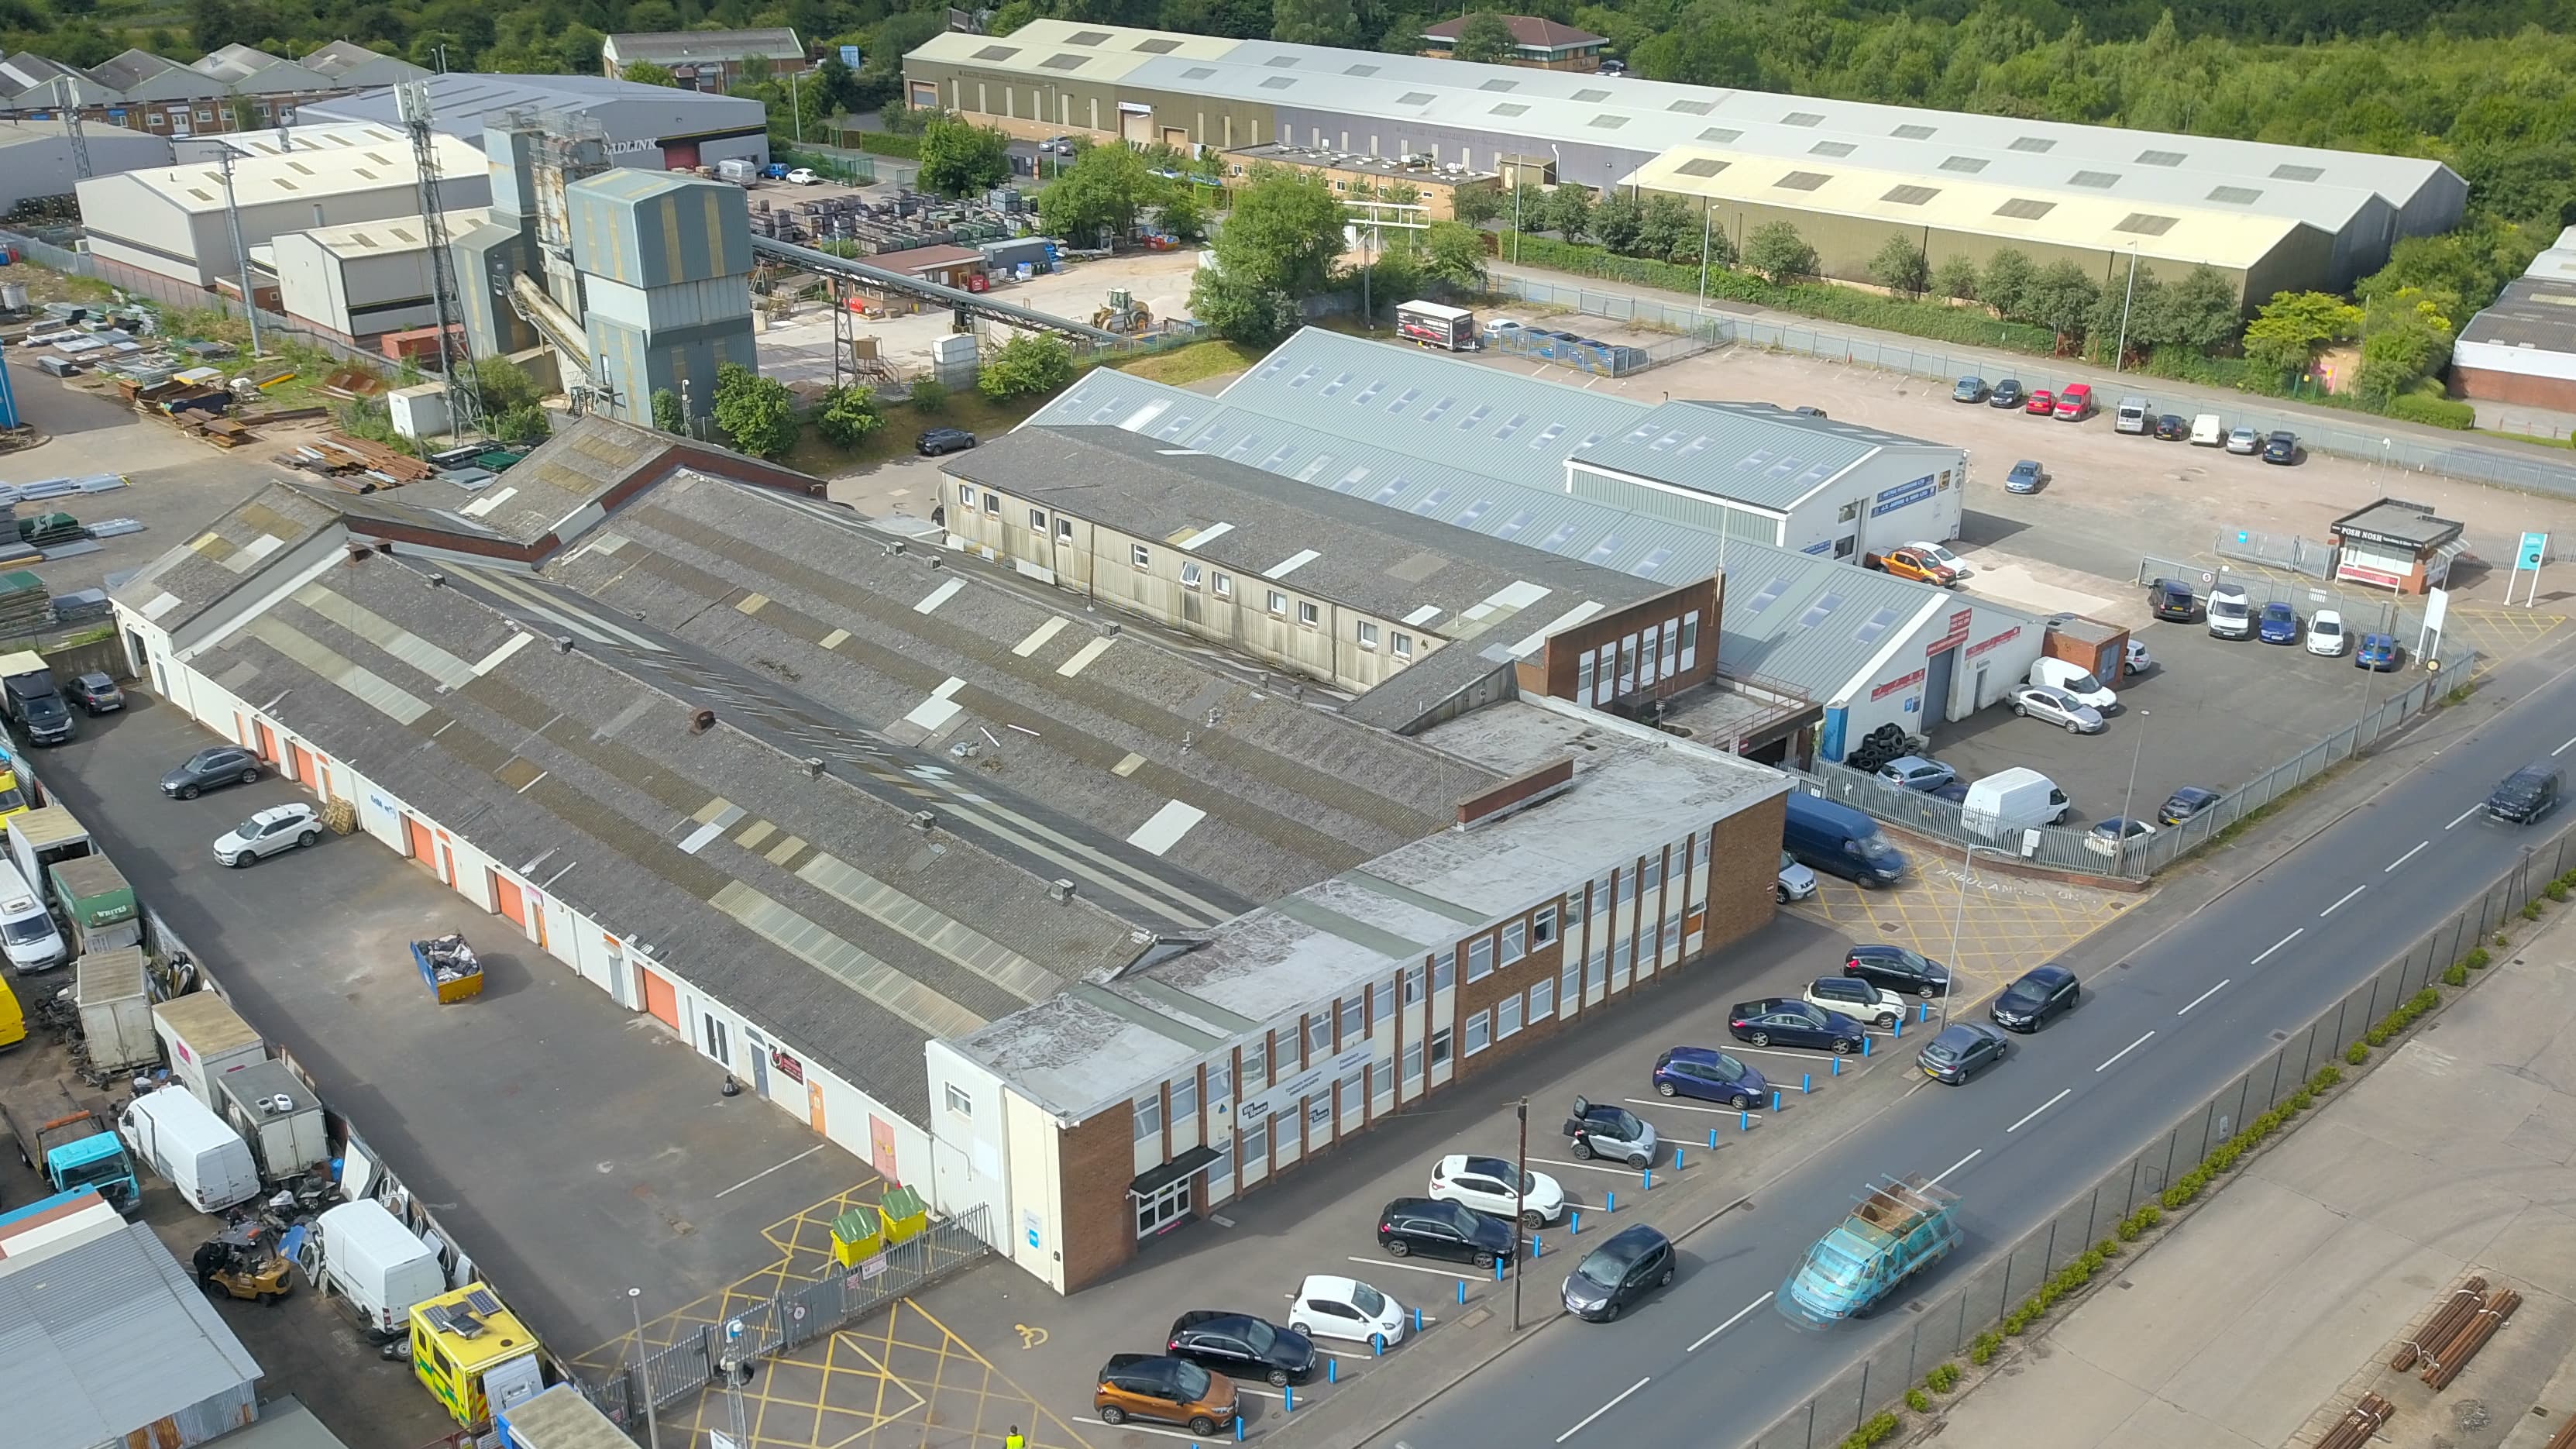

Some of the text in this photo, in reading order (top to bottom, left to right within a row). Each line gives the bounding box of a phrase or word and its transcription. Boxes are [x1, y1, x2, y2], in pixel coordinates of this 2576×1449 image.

[2341, 527, 2361, 537] POSH
[2361, 531, 2382, 542] NOSH
[97, 904, 127, 917] WHITES
